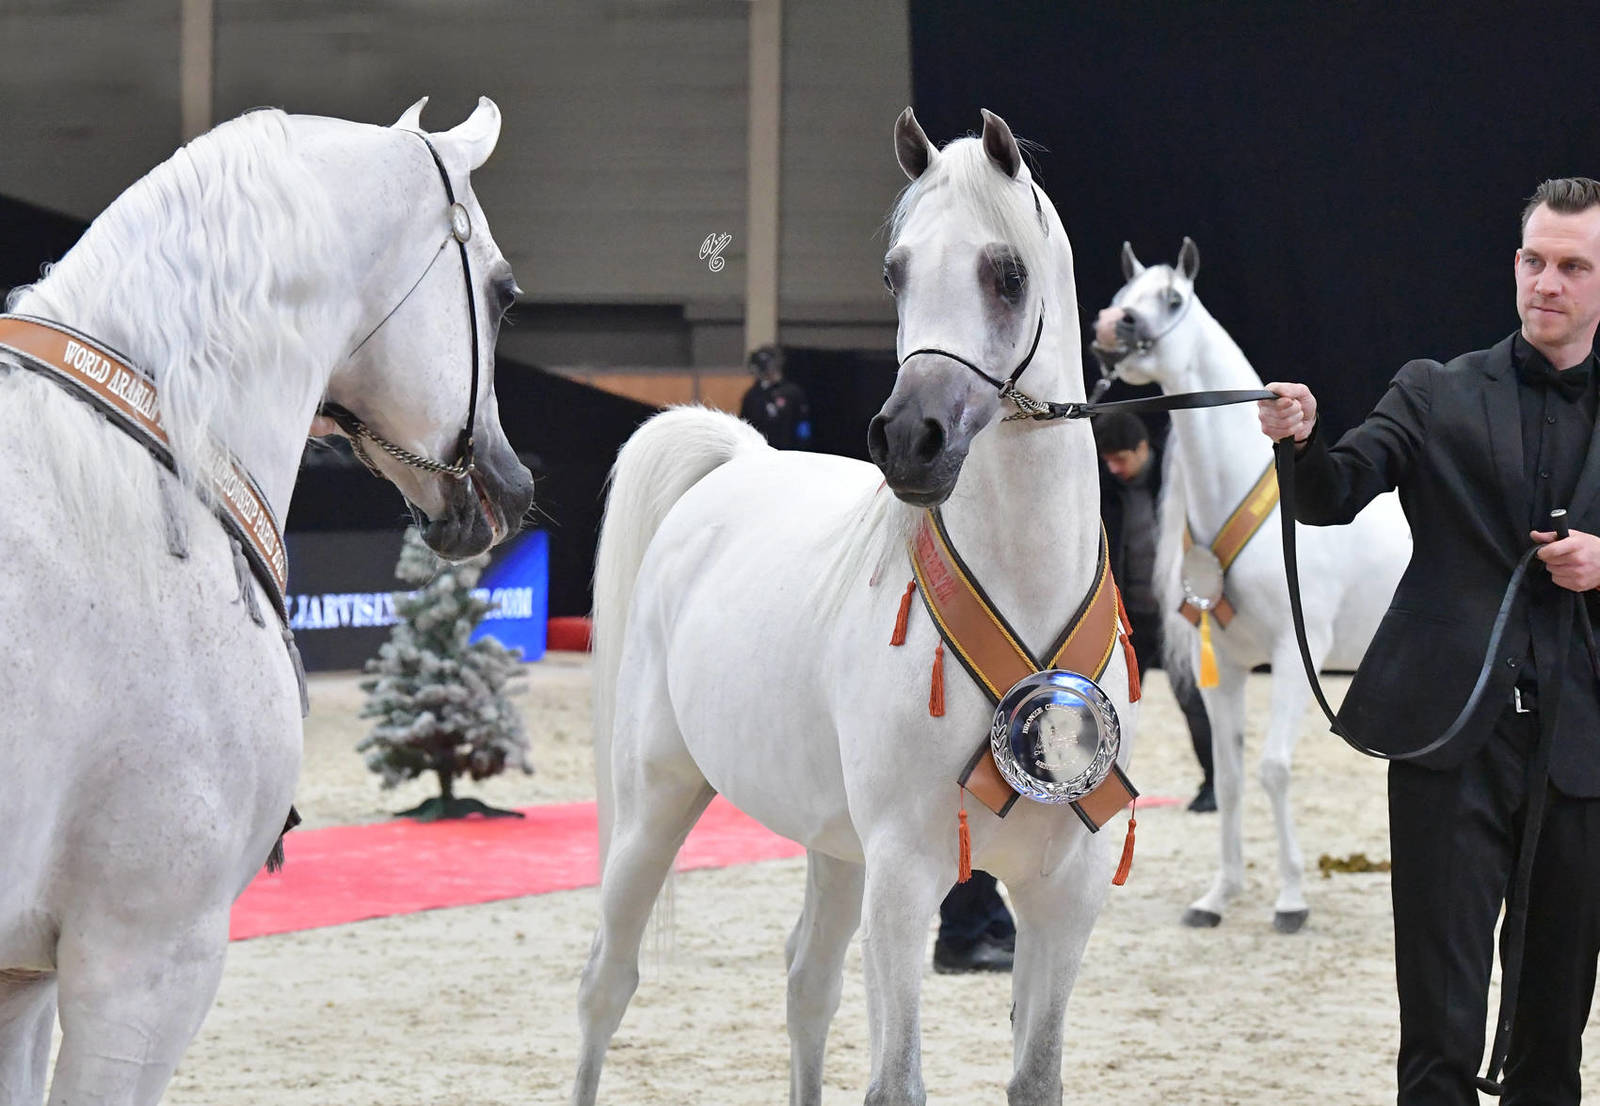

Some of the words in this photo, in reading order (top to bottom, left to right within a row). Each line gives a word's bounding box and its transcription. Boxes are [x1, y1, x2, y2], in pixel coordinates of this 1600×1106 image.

[63, 340, 111, 384] WORLD
[253, 511, 277, 556] PARIS
[1022, 706, 1044, 735] BRONZE
